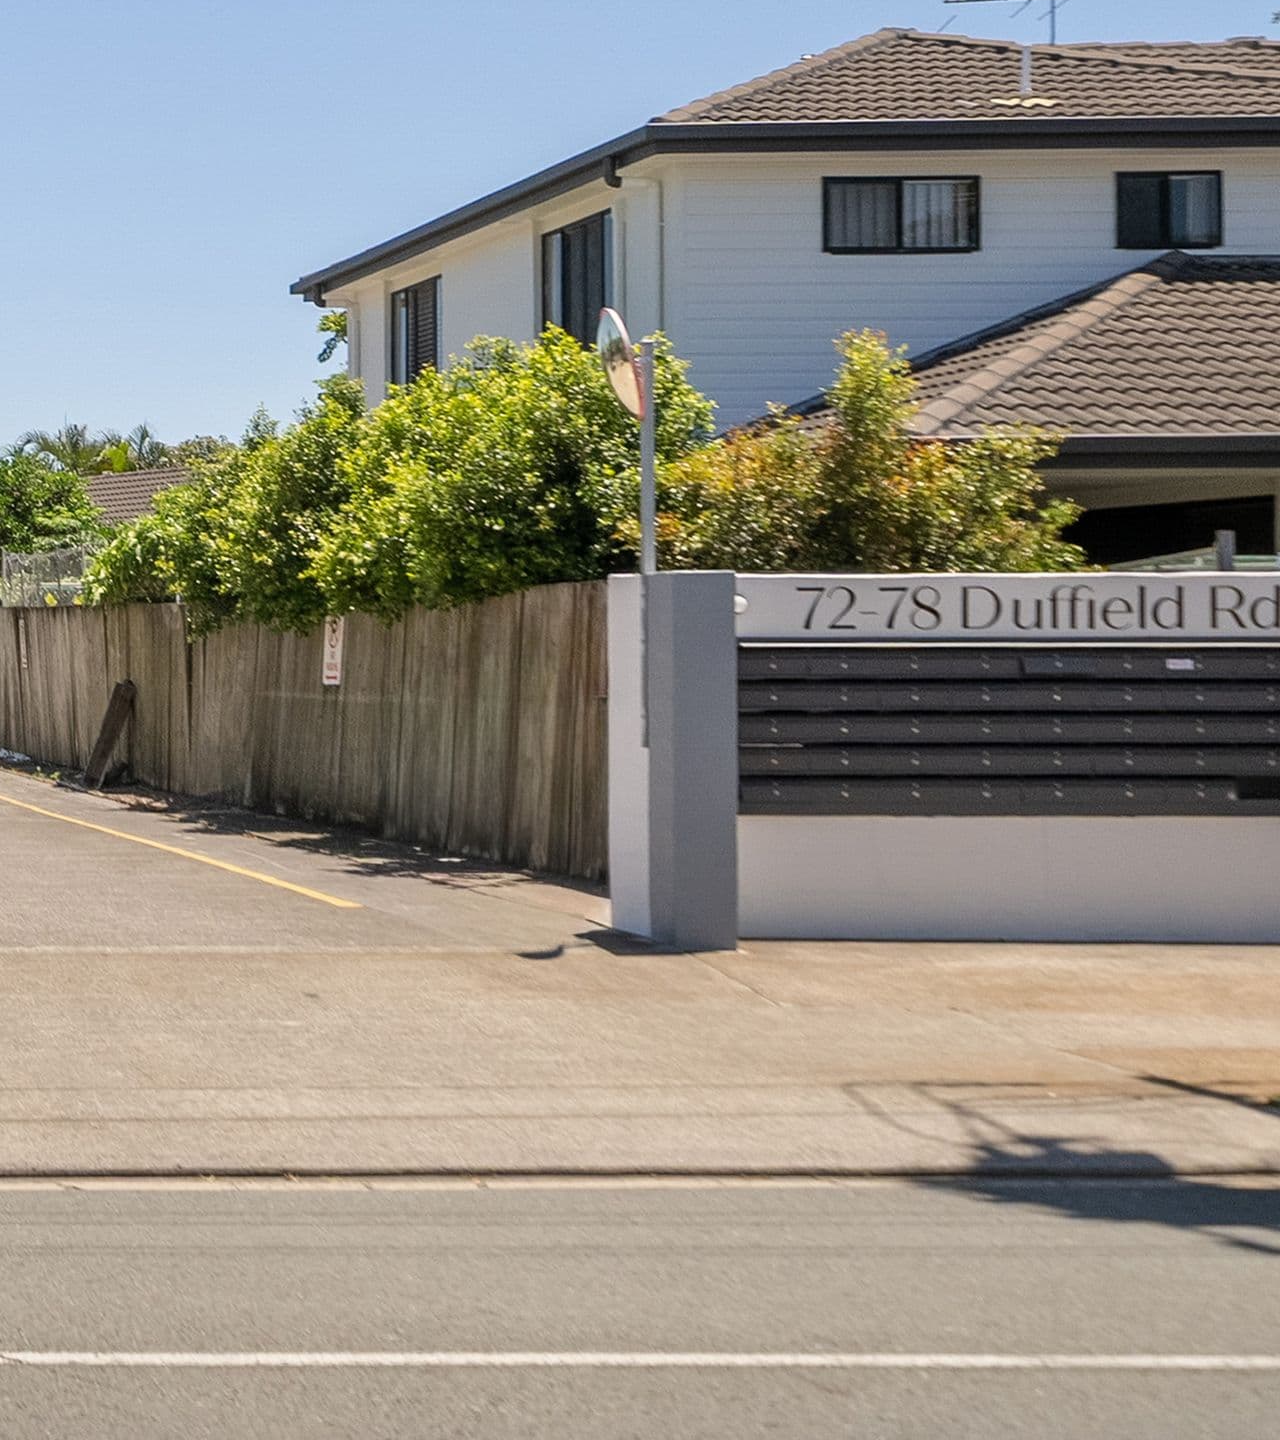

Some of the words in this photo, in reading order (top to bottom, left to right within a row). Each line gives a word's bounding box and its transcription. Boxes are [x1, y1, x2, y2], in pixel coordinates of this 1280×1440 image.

[796, 585, 942, 630] 72-78
[962, 584, 1184, 630] Duffield
[1209, 584, 1280, 630] Rd
